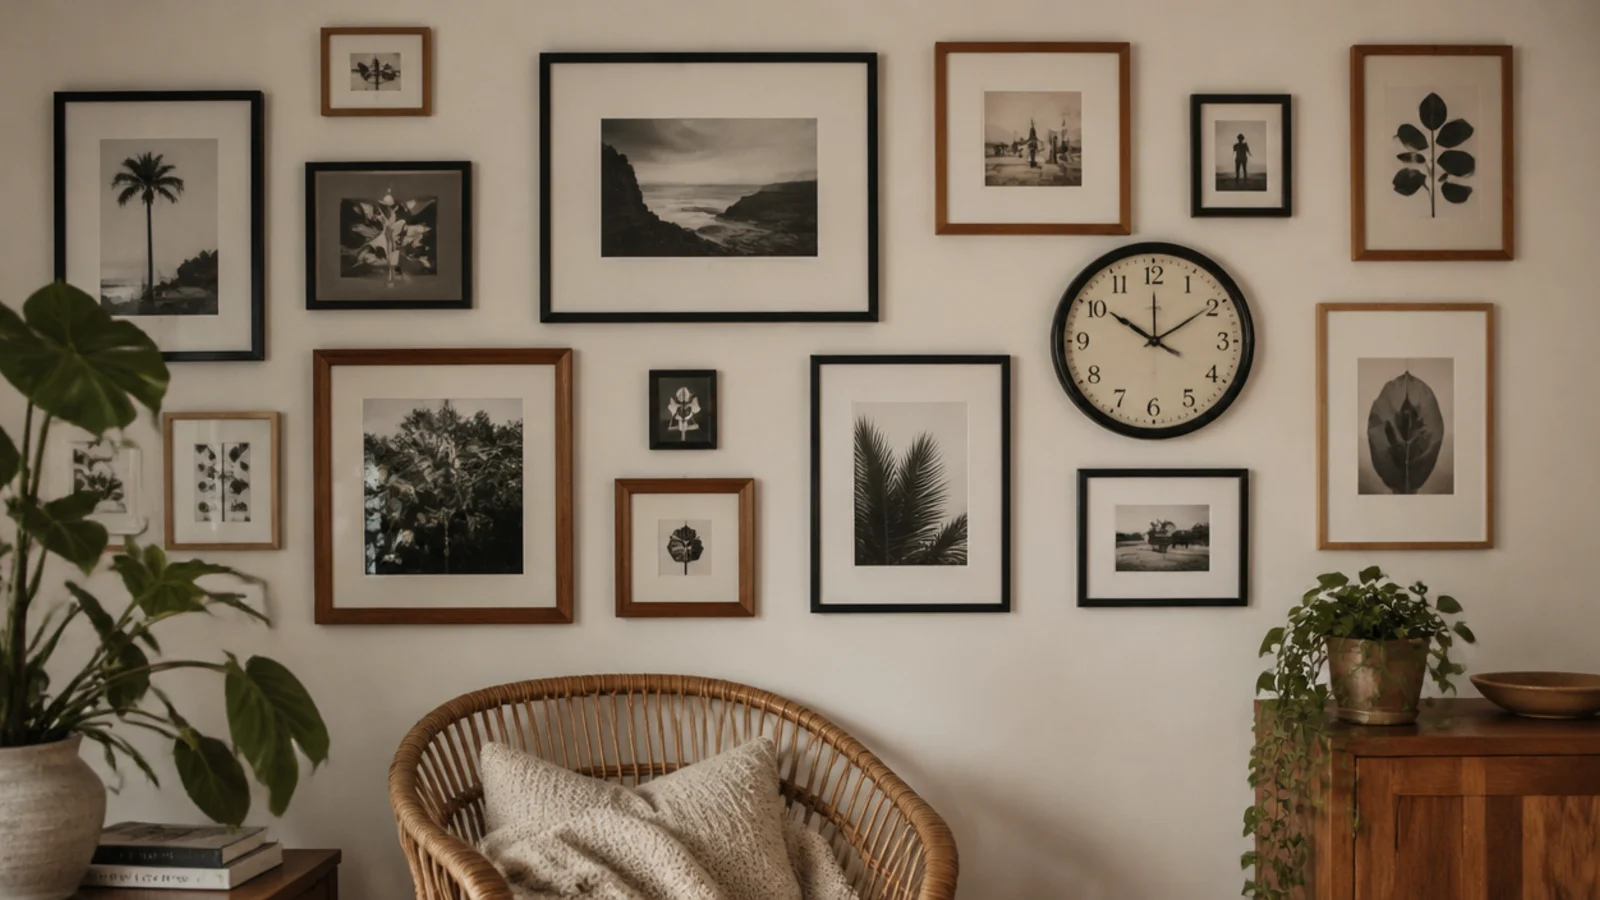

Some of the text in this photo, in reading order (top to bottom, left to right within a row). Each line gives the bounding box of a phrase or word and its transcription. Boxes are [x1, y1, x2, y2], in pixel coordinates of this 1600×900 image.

[1113, 275, 1127, 293] 11
[1145, 266, 1163, 285] 12
[1185, 276, 1191, 293] 1
[1088, 300, 1107, 318] 10
[1206, 299, 1218, 316] 2
[1076, 332, 1089, 350] 9
[1217, 332, 1229, 351] 3
[1088, 365, 1101, 384] 8
[1205, 365, 1218, 383] 4
[1114, 389, 1126, 408] 7
[1147, 398, 1160, 416] 6
[1183, 389, 1195, 408] 5
